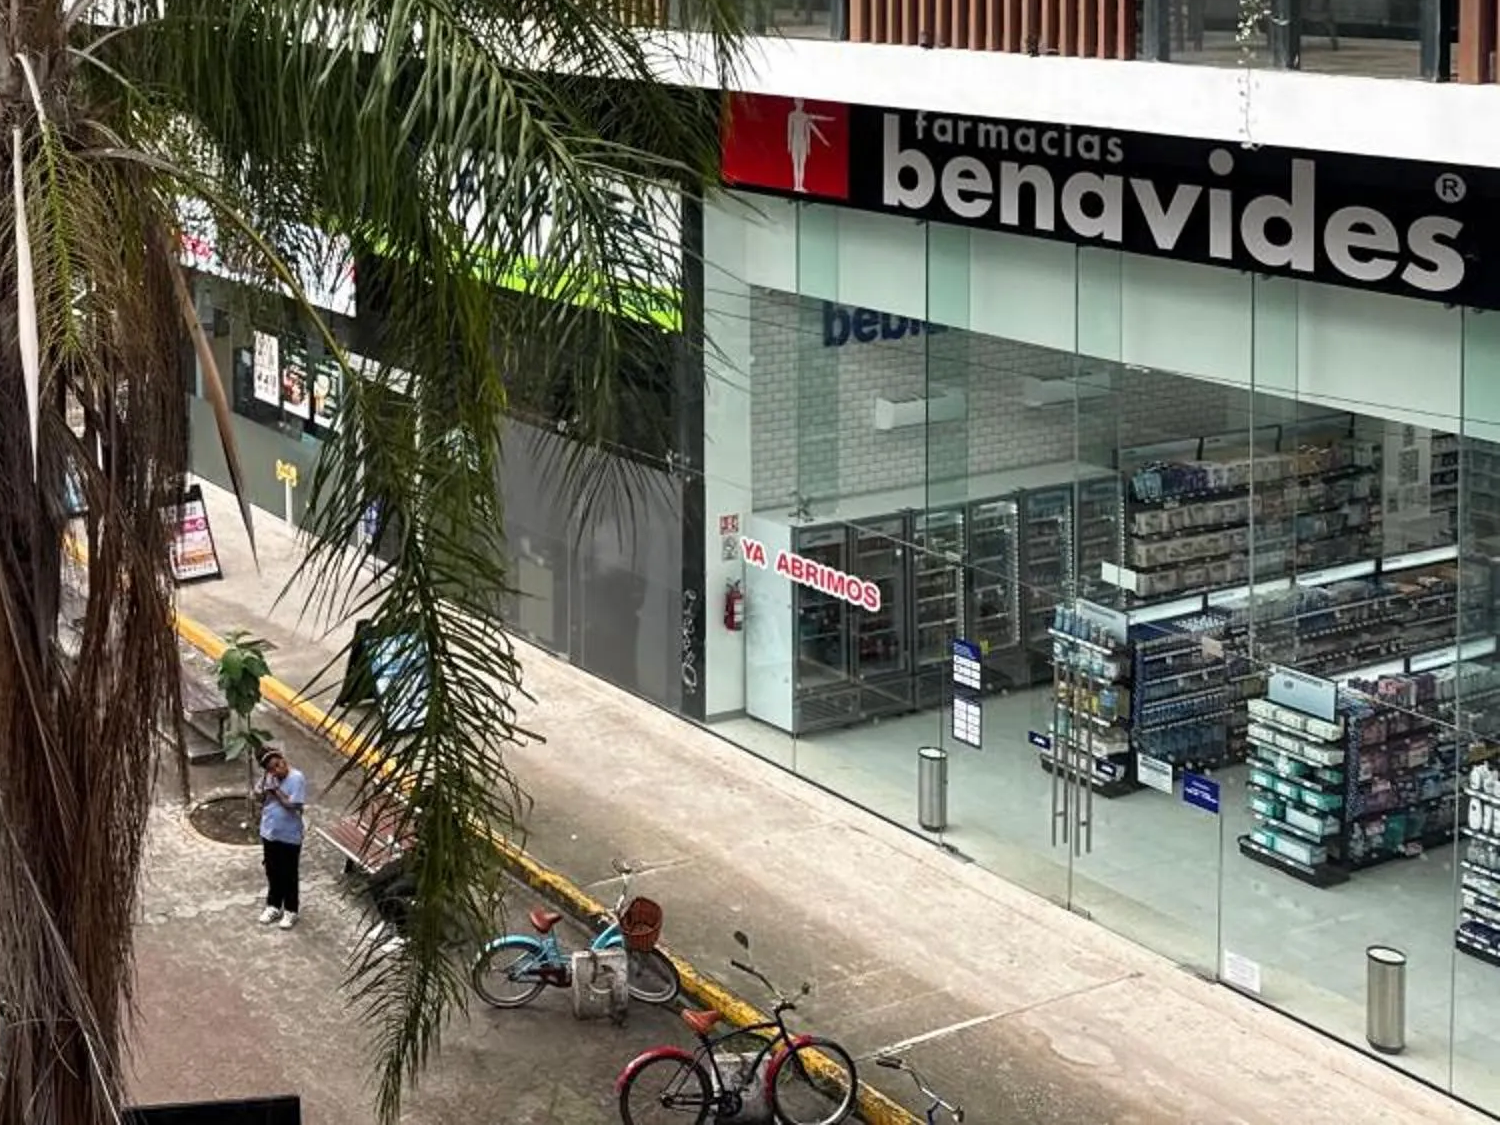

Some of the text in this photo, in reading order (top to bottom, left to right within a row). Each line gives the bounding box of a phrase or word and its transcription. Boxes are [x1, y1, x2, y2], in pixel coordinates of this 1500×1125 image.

[915, 111, 1124, 163] farmacias
[883, 114, 1465, 292] benavides
[742, 538, 879, 609] YA ABRIMOS
